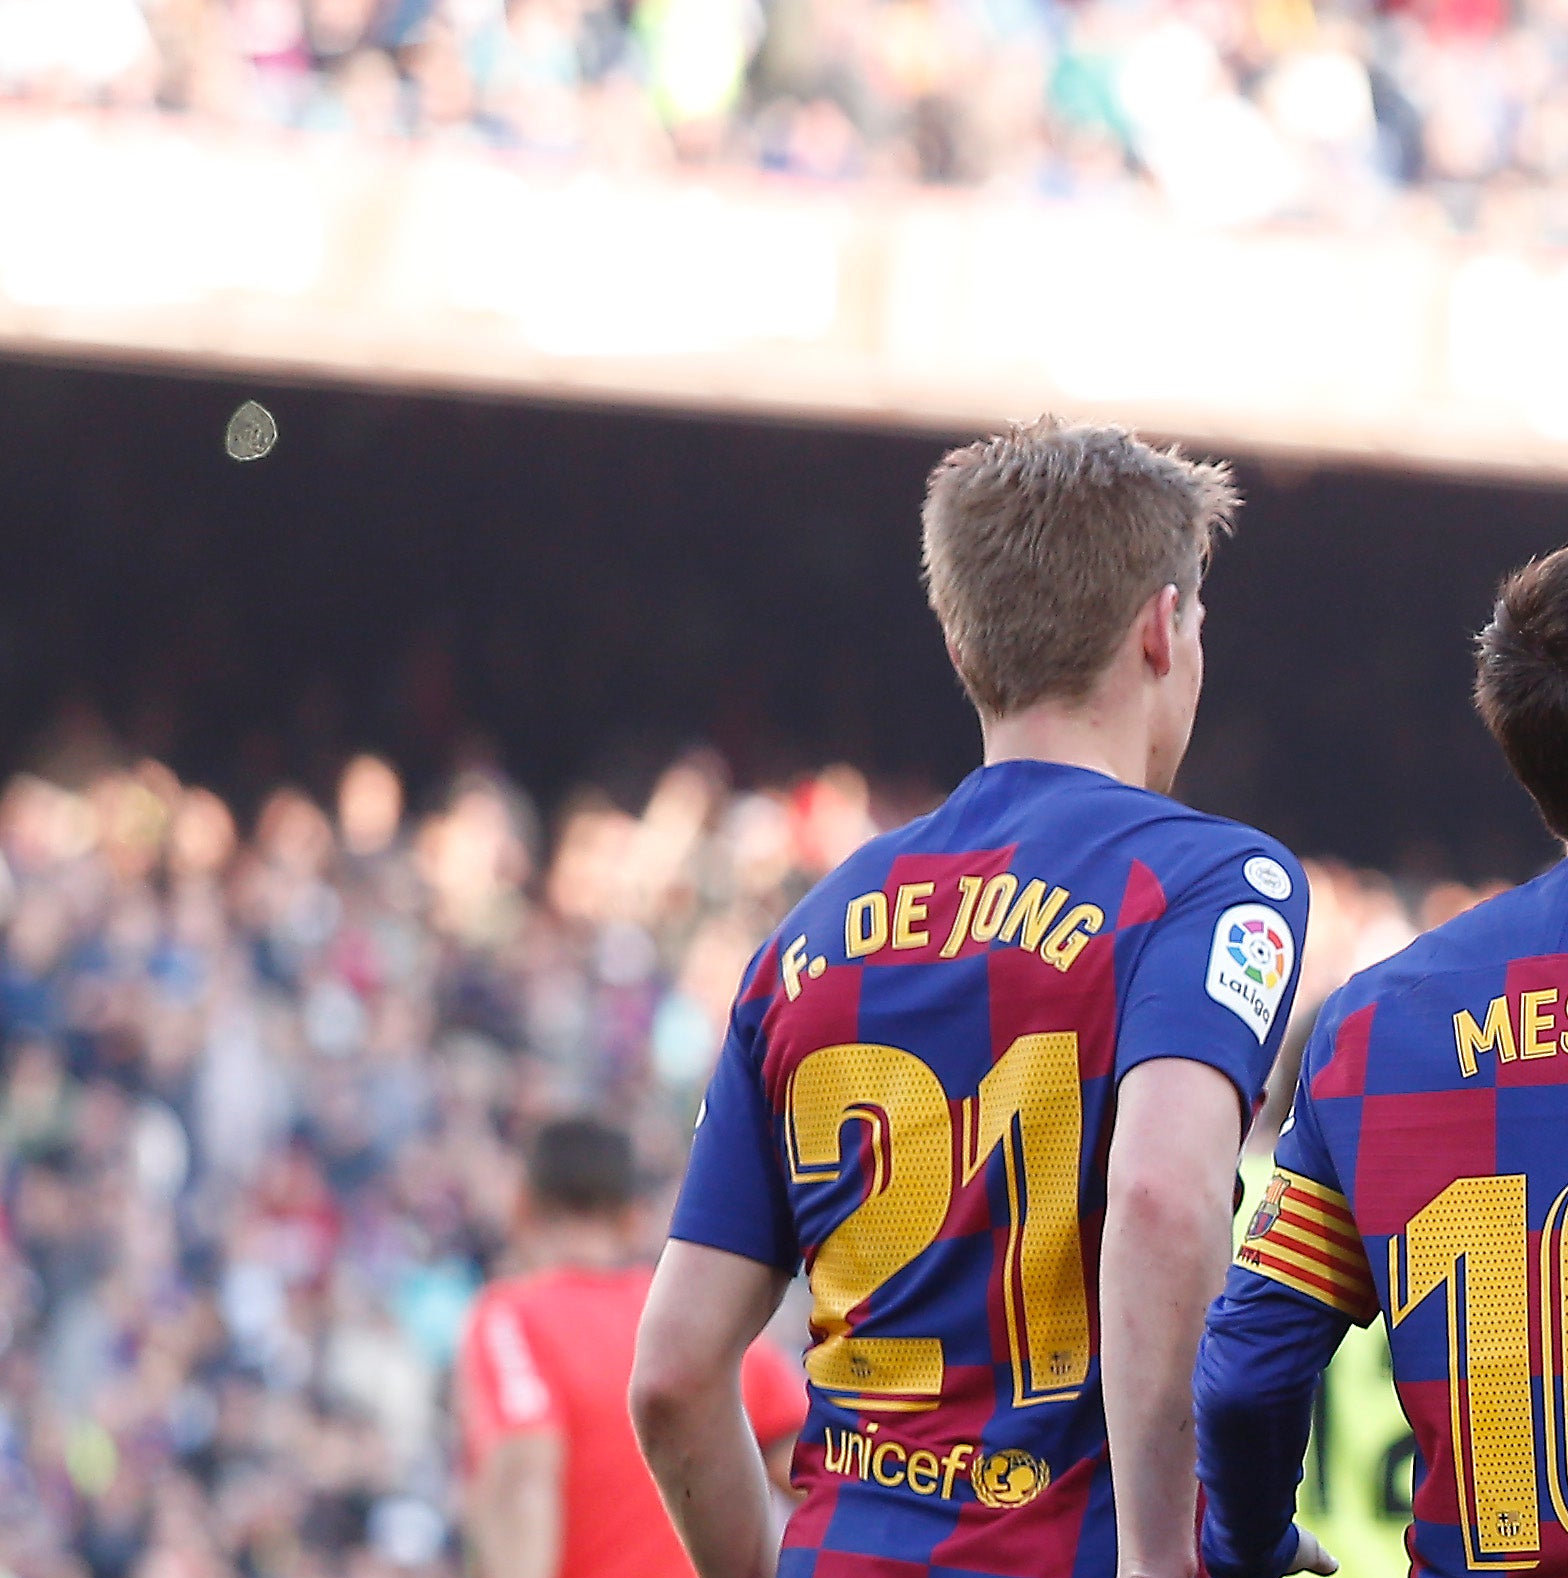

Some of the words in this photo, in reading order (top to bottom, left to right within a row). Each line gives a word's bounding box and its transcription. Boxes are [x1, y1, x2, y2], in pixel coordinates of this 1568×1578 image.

[781, 933, 828, 1002] F.
[844, 881, 936, 959] DE
[938, 872, 1105, 973] JONG
[1219, 971, 1272, 1025] LaLiga
[785, 1030, 1090, 1411] 21
[824, 1422, 975, 1501] unicef
